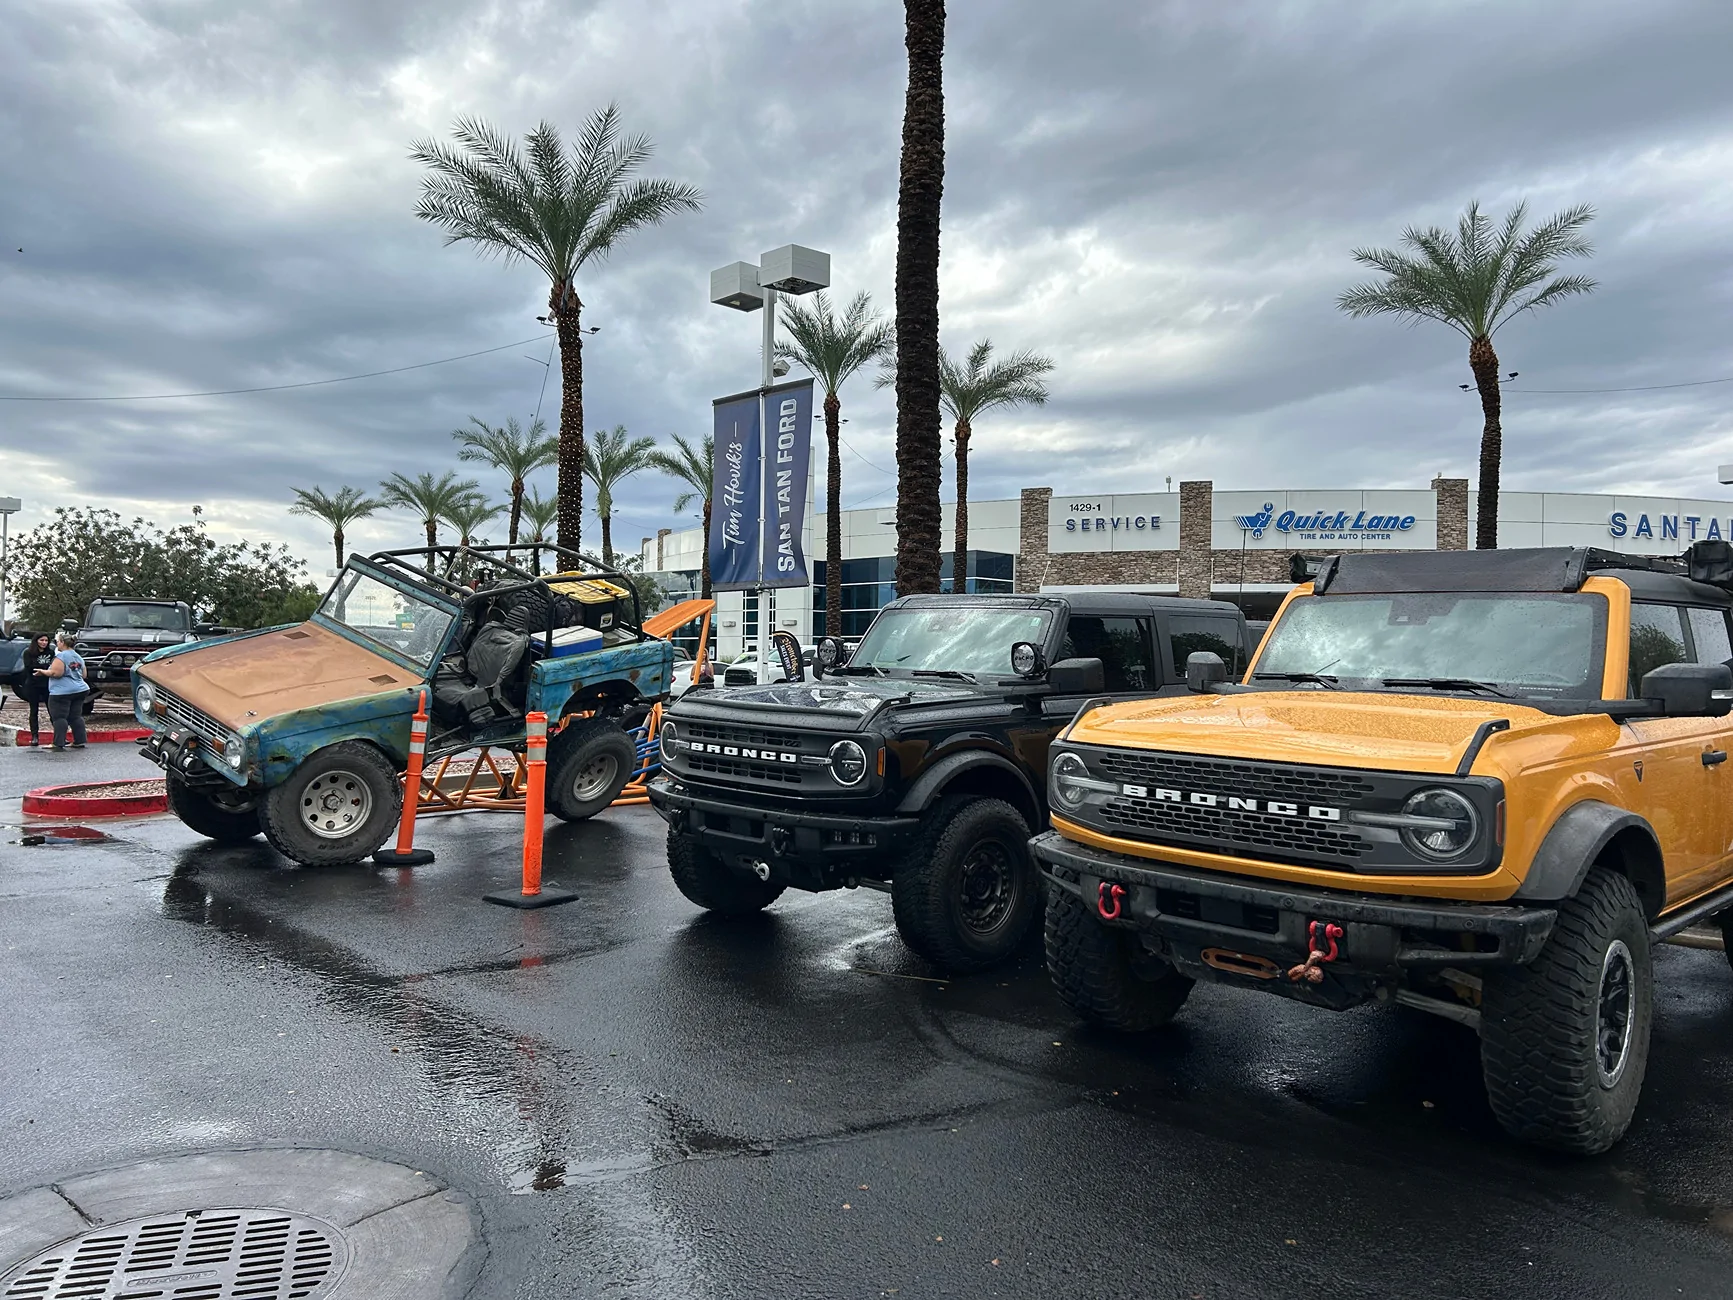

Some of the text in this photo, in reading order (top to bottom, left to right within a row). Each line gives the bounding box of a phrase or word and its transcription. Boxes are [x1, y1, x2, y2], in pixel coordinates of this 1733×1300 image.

[722, 441, 746, 550] Tim Hovik's
[777, 398, 797, 572] SAN TAN FORD
[1069, 503, 1101, 512] 1429-1
[1066, 516, 1161, 531] SERVICE
[1275, 510, 1416, 533] Quick Lane
[1608, 511, 1733, 542] SANTA
[690, 742, 797, 763] BRONCO
[1122, 783, 1341, 821] BRONCO
